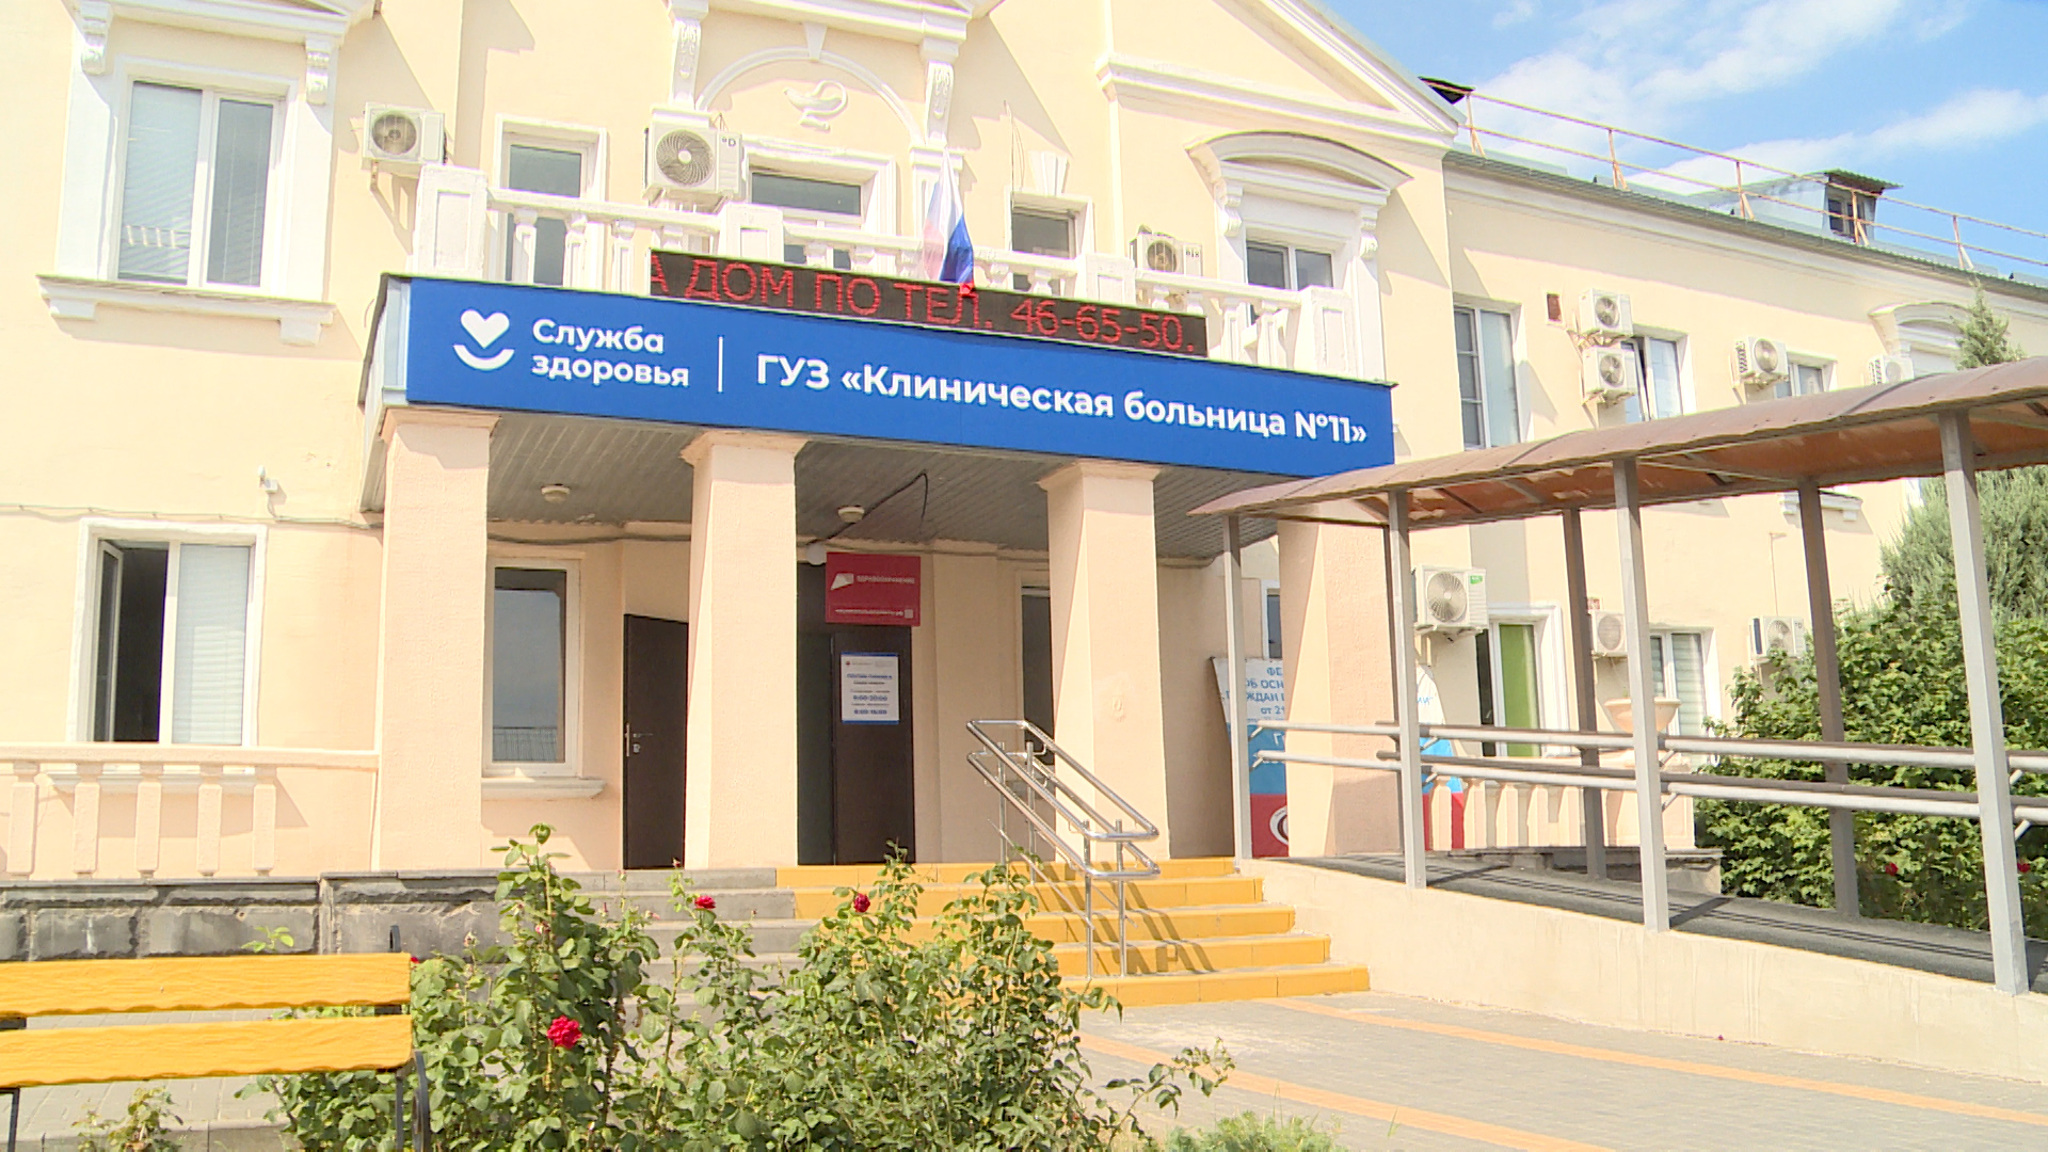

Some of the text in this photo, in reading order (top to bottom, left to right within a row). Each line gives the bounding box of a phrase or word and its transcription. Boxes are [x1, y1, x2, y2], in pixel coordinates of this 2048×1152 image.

[684, 259, 794, 307] ДОМ
[815, 274, 881, 315] ПО
[532, 318, 665, 353] Служба
[532, 354, 689, 387] здоровья
[757, 354, 830, 389] ГУЗ
[841, 364, 1114, 418] «Клиническая
[1124, 390, 1286, 437] больница
